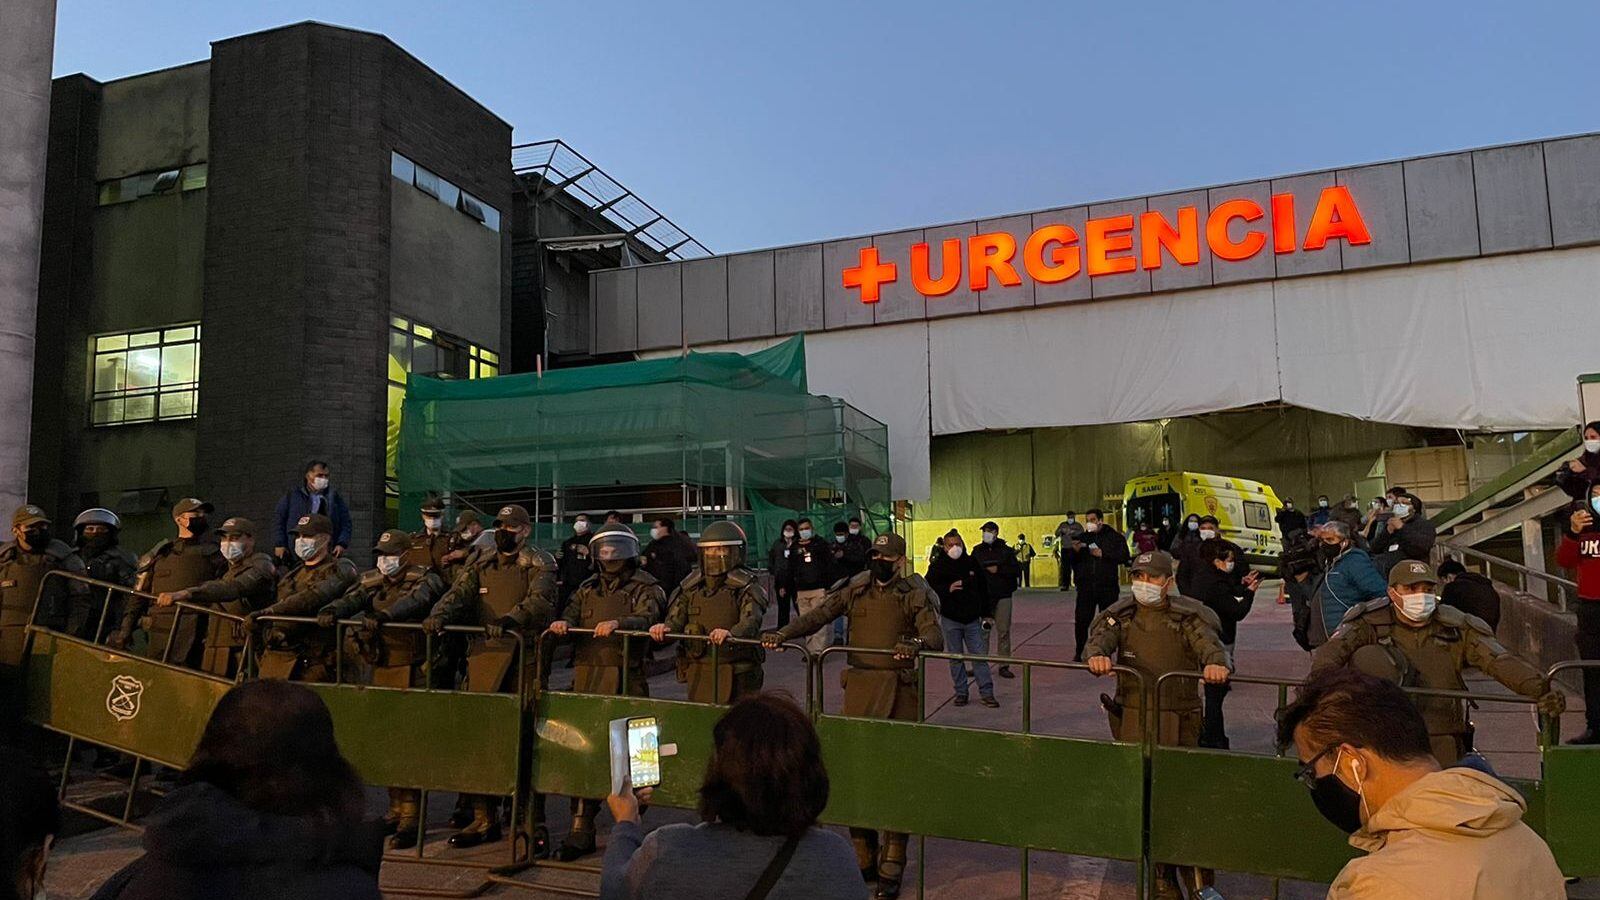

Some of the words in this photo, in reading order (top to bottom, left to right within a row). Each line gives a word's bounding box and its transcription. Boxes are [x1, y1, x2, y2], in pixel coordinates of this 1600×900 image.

[911, 185, 1371, 296] URGENCIA
[1142, 484, 1163, 493] SAMU
[1580, 540, 1600, 554] UK
